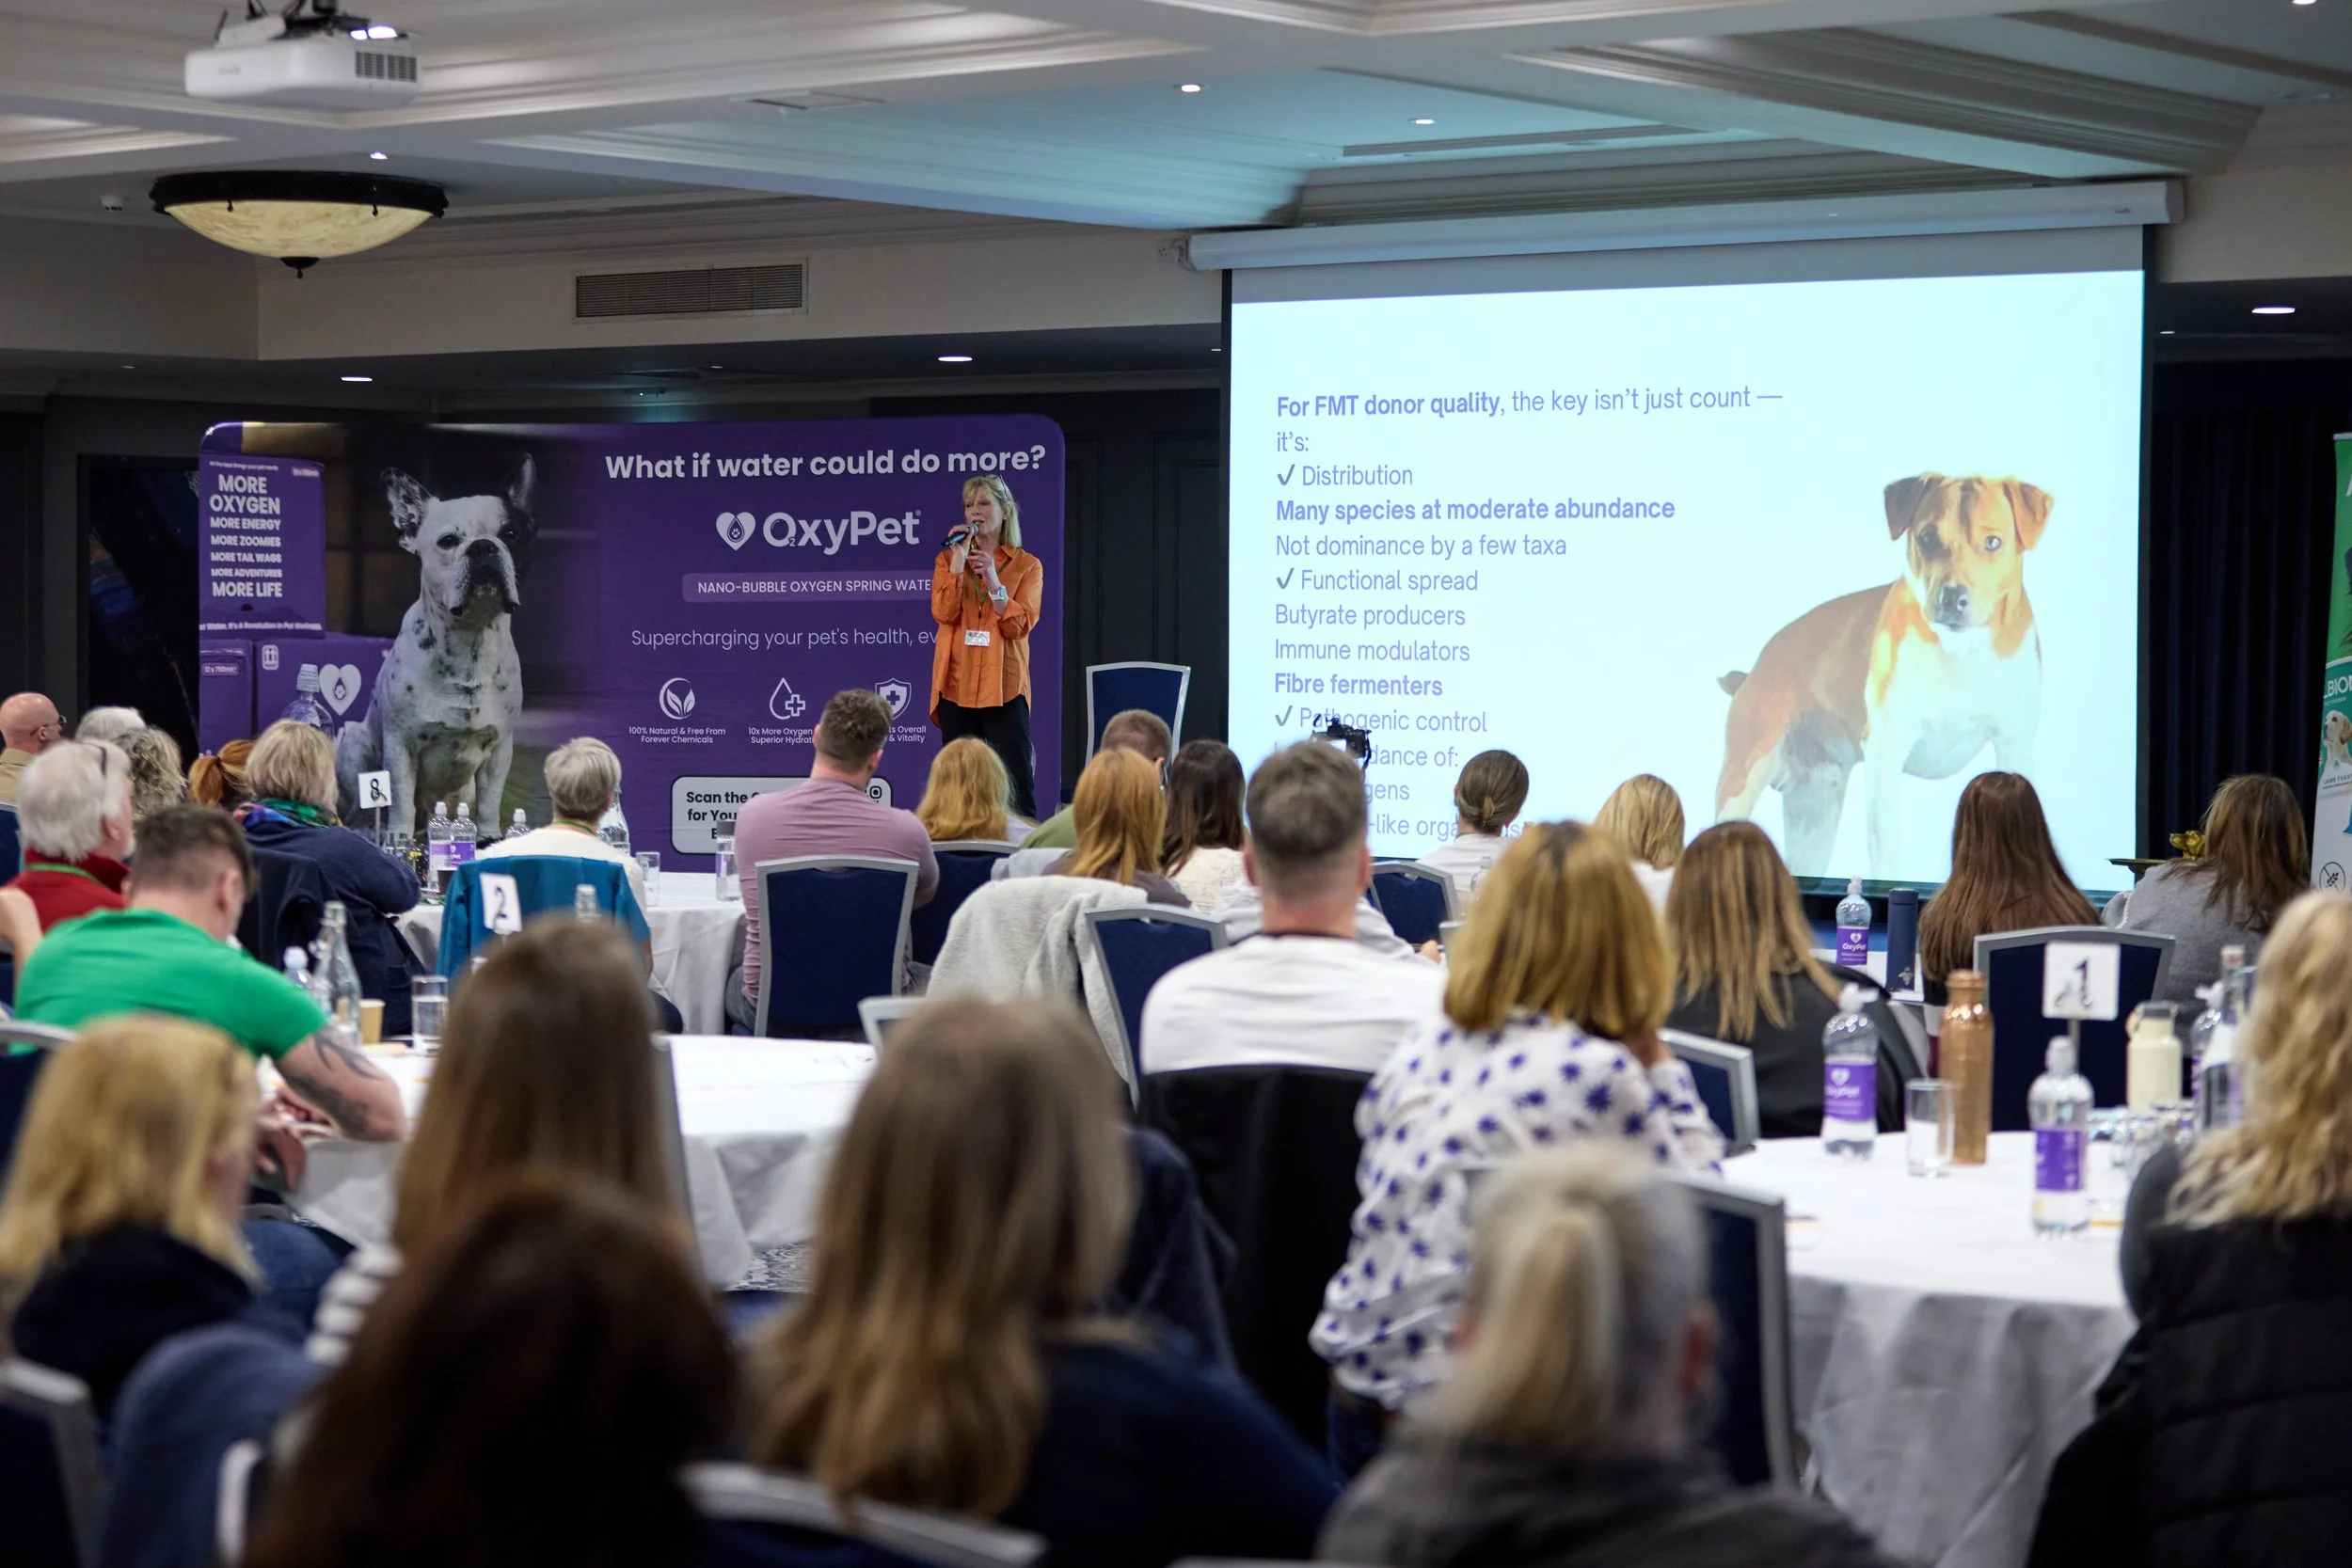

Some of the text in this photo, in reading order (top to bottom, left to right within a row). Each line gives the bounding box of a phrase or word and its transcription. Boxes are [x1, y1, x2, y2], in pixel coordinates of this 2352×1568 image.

[1278, 396, 1310, 417] For
[1315, 395, 1359, 416] FMT
[1364, 394, 1425, 415] donor
[1430, 391, 1505, 419] quality,
[1512, 390, 1545, 411] the
[1551, 389, 1588, 416] key
[1595, 388, 1639, 410] isn’t
[1643, 387, 1683, 415] just
[1690, 386, 1751, 408] count
[605, 445, 1046, 479] What if water could do more?
[218, 474, 267, 494] MORE
[1302, 465, 1413, 486] Distribution
[209, 494, 280, 515] OXYGEN
[1277, 498, 1676, 525] Many species at moderate abundance
[211, 516, 281, 531] MORE ENERGY
[211, 535, 281, 547] MORE ZOOMIES
[1277, 534, 1566, 561] Not dominance by a few taxa
[211, 551, 282, 563] MORE TAIL WAGS
[211, 568, 282, 578] MORE ADVENTURES
[1301, 569, 1478, 594] Functional spread
[213, 581, 282, 597] MORE LIFE
[697, 579, 931, 594] NANO-BUBBLE OXYGEN SPRING WATE
[1276, 604, 1466, 630] Butyrate producers
[631, 629, 759, 650] Supercharging
[764, 632, 803, 650] your
[808, 628, 849, 649] pet's
[853, 627, 913, 647] health,
[1275, 639, 1470, 661] Immune modulators
[1275, 673, 1443, 696] Fibre fermenters
[628, 726, 647, 735] 100%
[898, 725, 927, 734] Overall
[1416, 711, 1487, 733] control
[671, 736, 714, 744] Chemicals
[748, 727, 760, 736] 10x
[783, 727, 813, 737] Oxygen
[751, 736, 784, 746] Superior
[888, 734, 926, 744] & Vitality
[1434, 746, 1459, 768] of:
[686, 791, 722, 803] Scan
[724, 790, 747, 803] the
[687, 808, 707, 821] for
